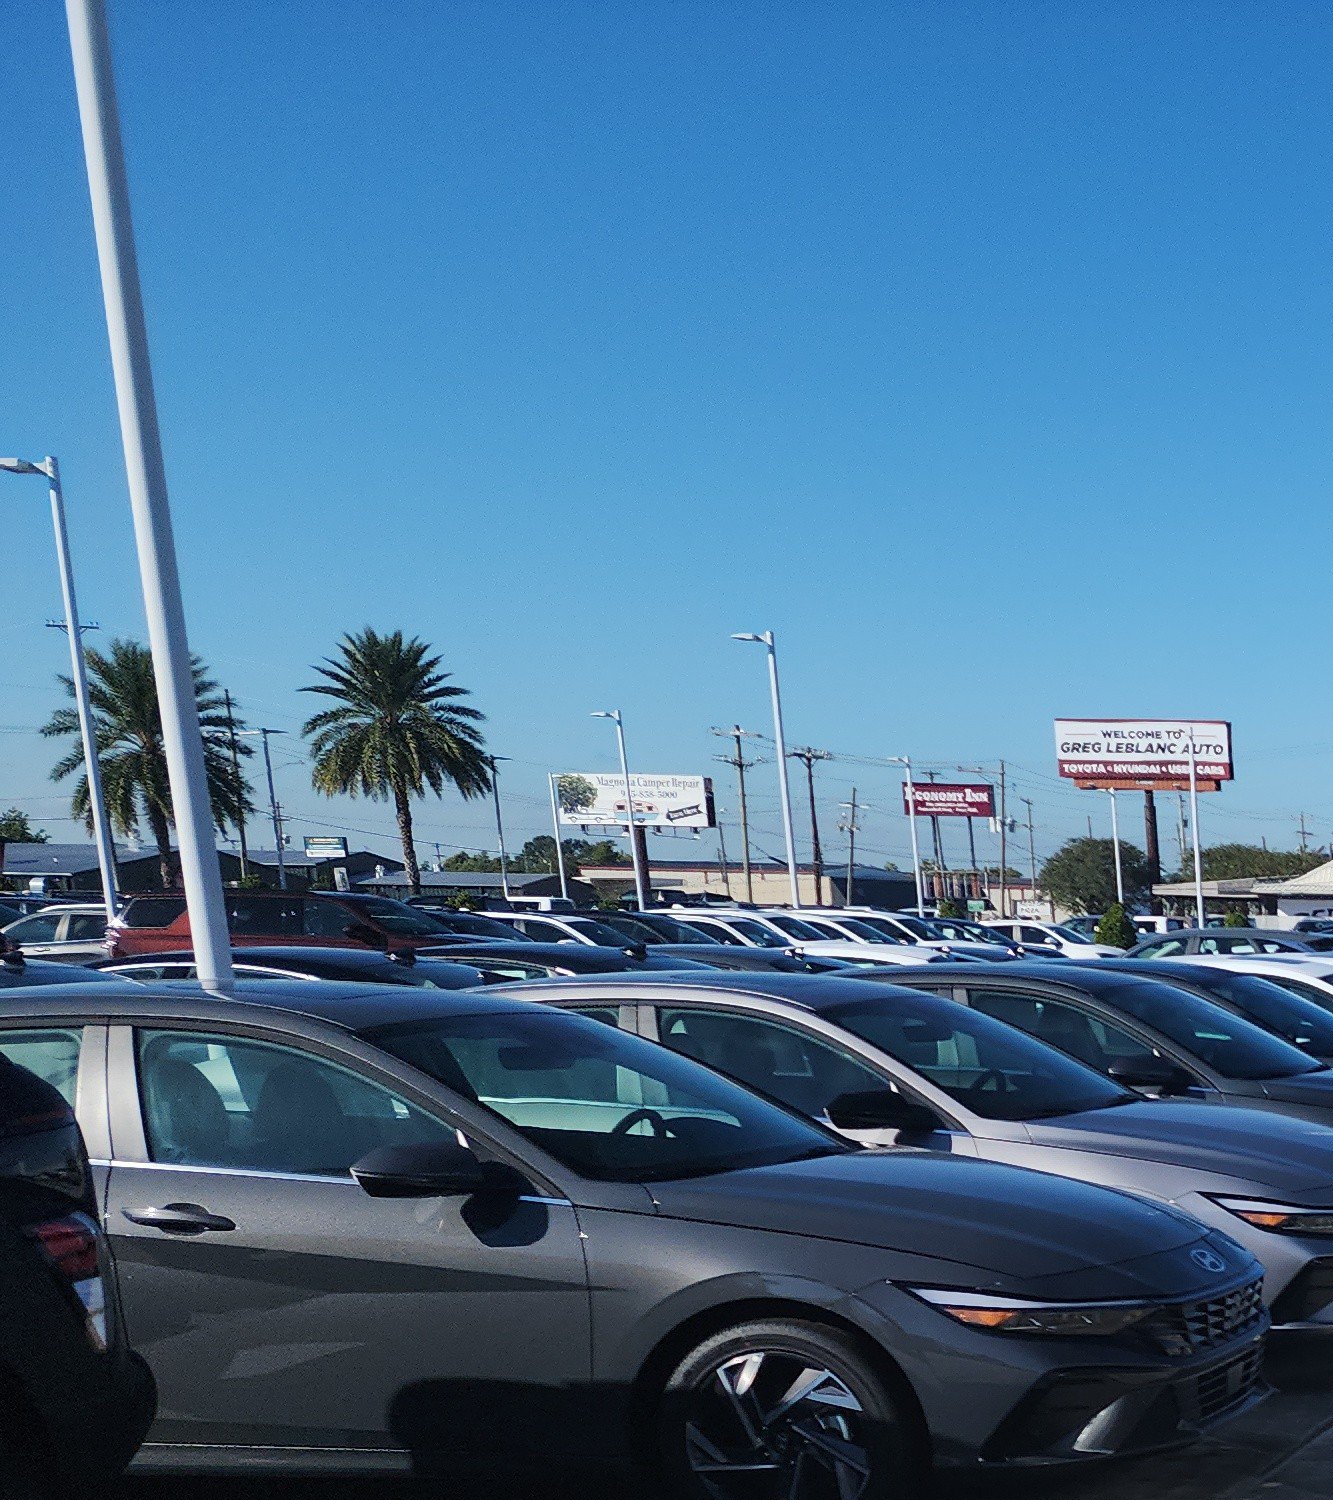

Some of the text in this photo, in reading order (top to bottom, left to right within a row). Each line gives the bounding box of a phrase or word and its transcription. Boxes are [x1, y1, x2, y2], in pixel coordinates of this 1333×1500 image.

[1101, 730, 1182, 740] WELCOME TO
[1061, 742, 1101, 753] GREG
[1106, 742, 1177, 754] LEBLANC
[1062, 763, 1225, 775] TOYOTA HYUNDAI USE CARS
[636, 777, 671, 790] Camper
[671, 778, 700, 791] Repair
